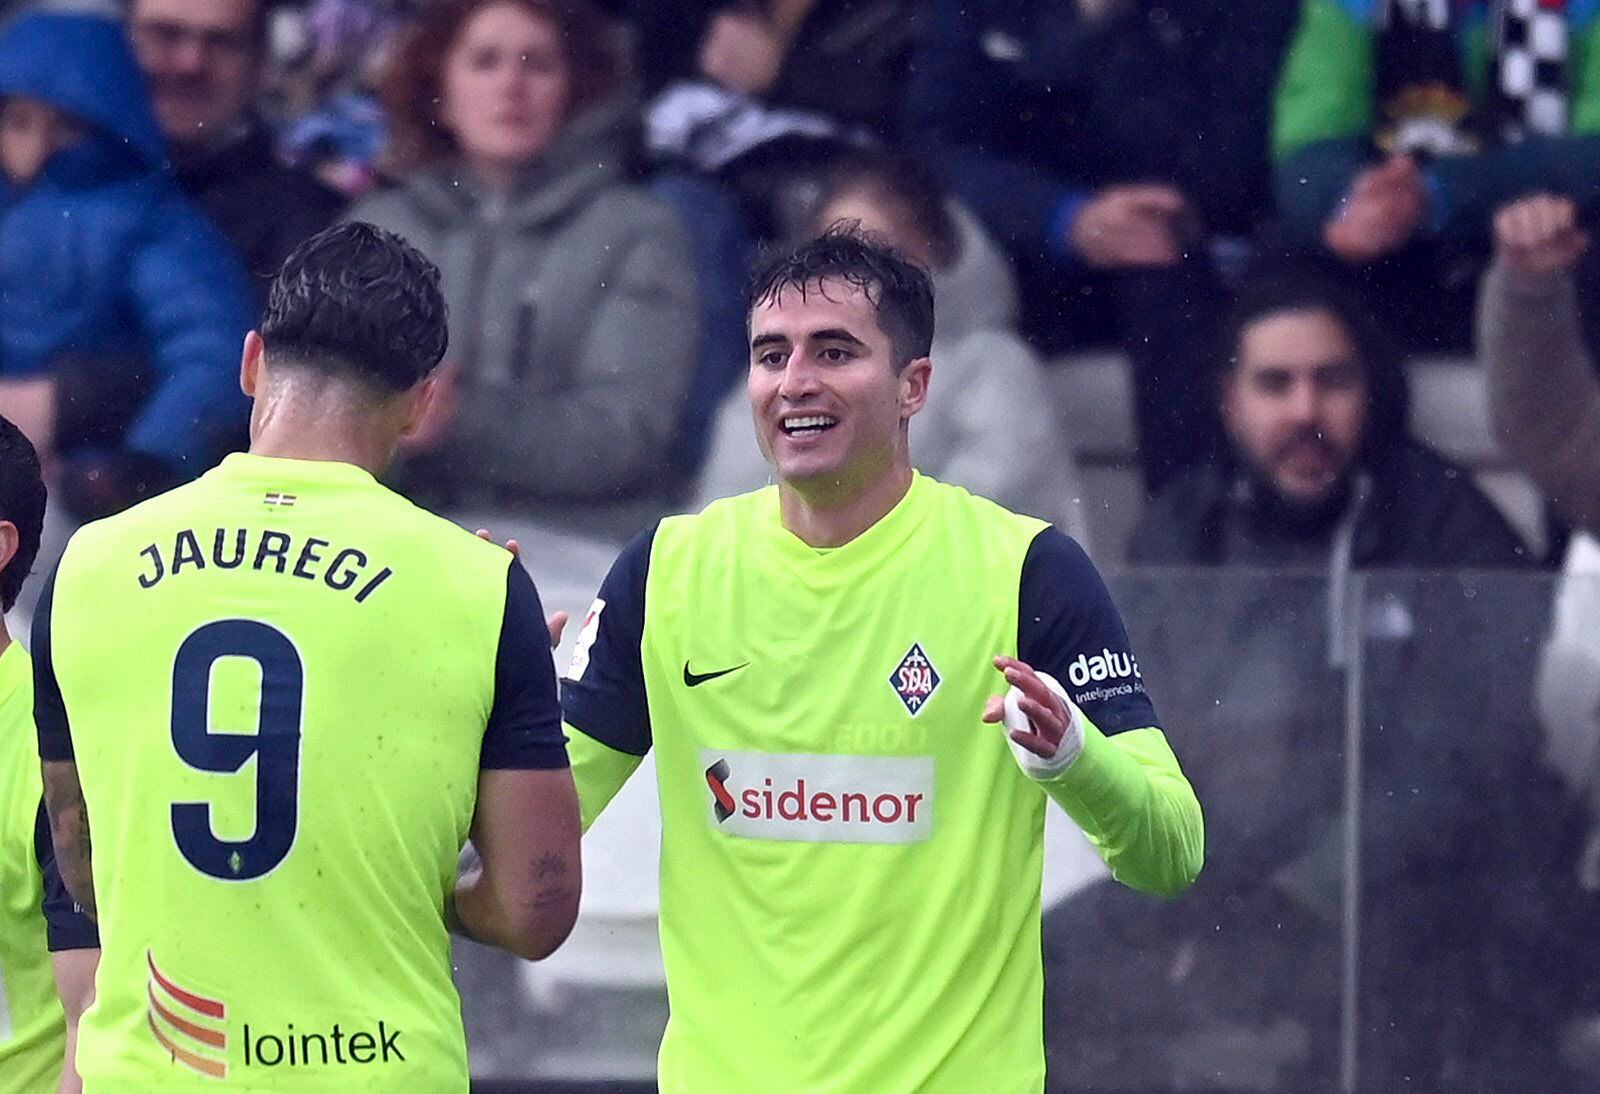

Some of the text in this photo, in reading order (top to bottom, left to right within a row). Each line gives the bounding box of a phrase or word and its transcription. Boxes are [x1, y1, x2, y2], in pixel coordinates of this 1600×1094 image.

[137, 527, 393, 604] JAUREGI
[1075, 683, 1133, 704] Inteligencia
[170, 618, 304, 881] 9
[741, 777, 925, 823] sidenor
[243, 1020, 406, 1067] lointek
